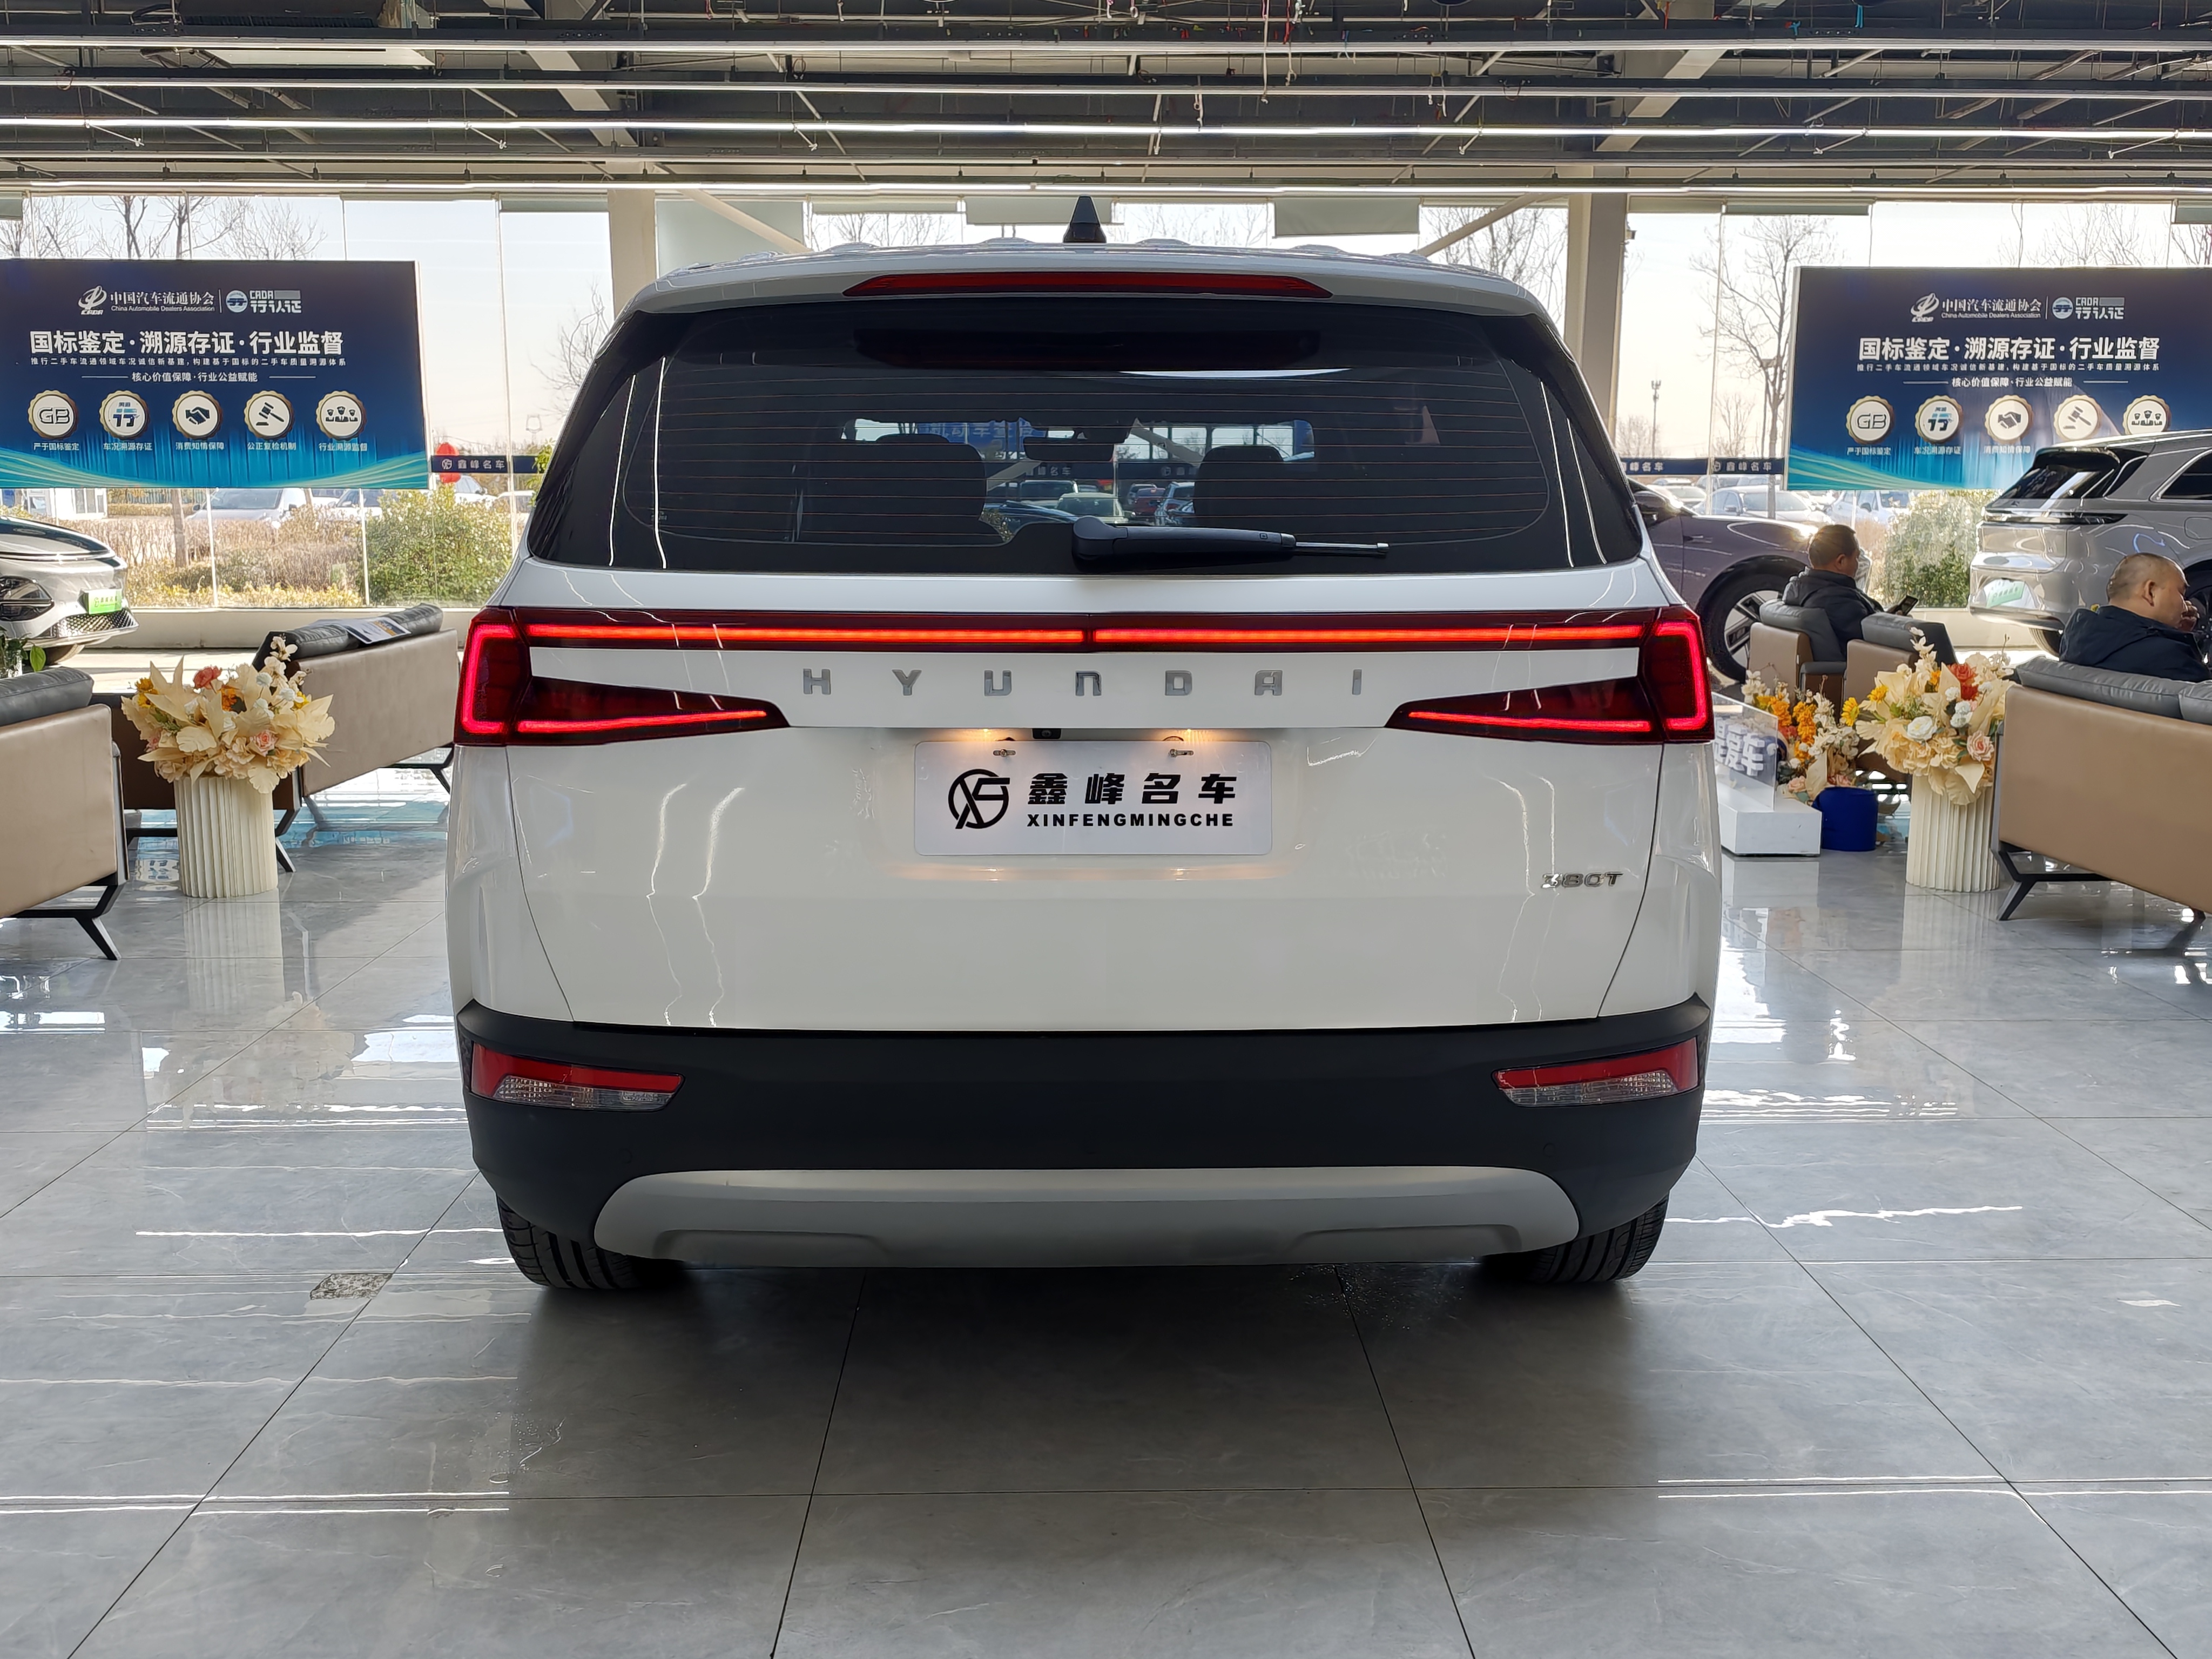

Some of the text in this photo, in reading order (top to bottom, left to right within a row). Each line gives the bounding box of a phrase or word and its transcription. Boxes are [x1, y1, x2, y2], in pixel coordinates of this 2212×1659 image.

[110, 292, 214, 305] 中国汽车流通协会
[249, 290, 274, 300] CADA
[250, 300, 302, 313] 行认证
[1943, 299, 2041, 312] 中国汽车流通协会
[2075, 298, 2099, 306] CADA
[2075, 307, 2125, 319] 行认证
[802, 669, 1362, 697] HYUNDAI
[1027, 772, 1237, 805] 鑫峰名车
[1027, 813, 1233, 827] XINFENGMINGCHE
[1541, 872, 1624, 888] 380T
